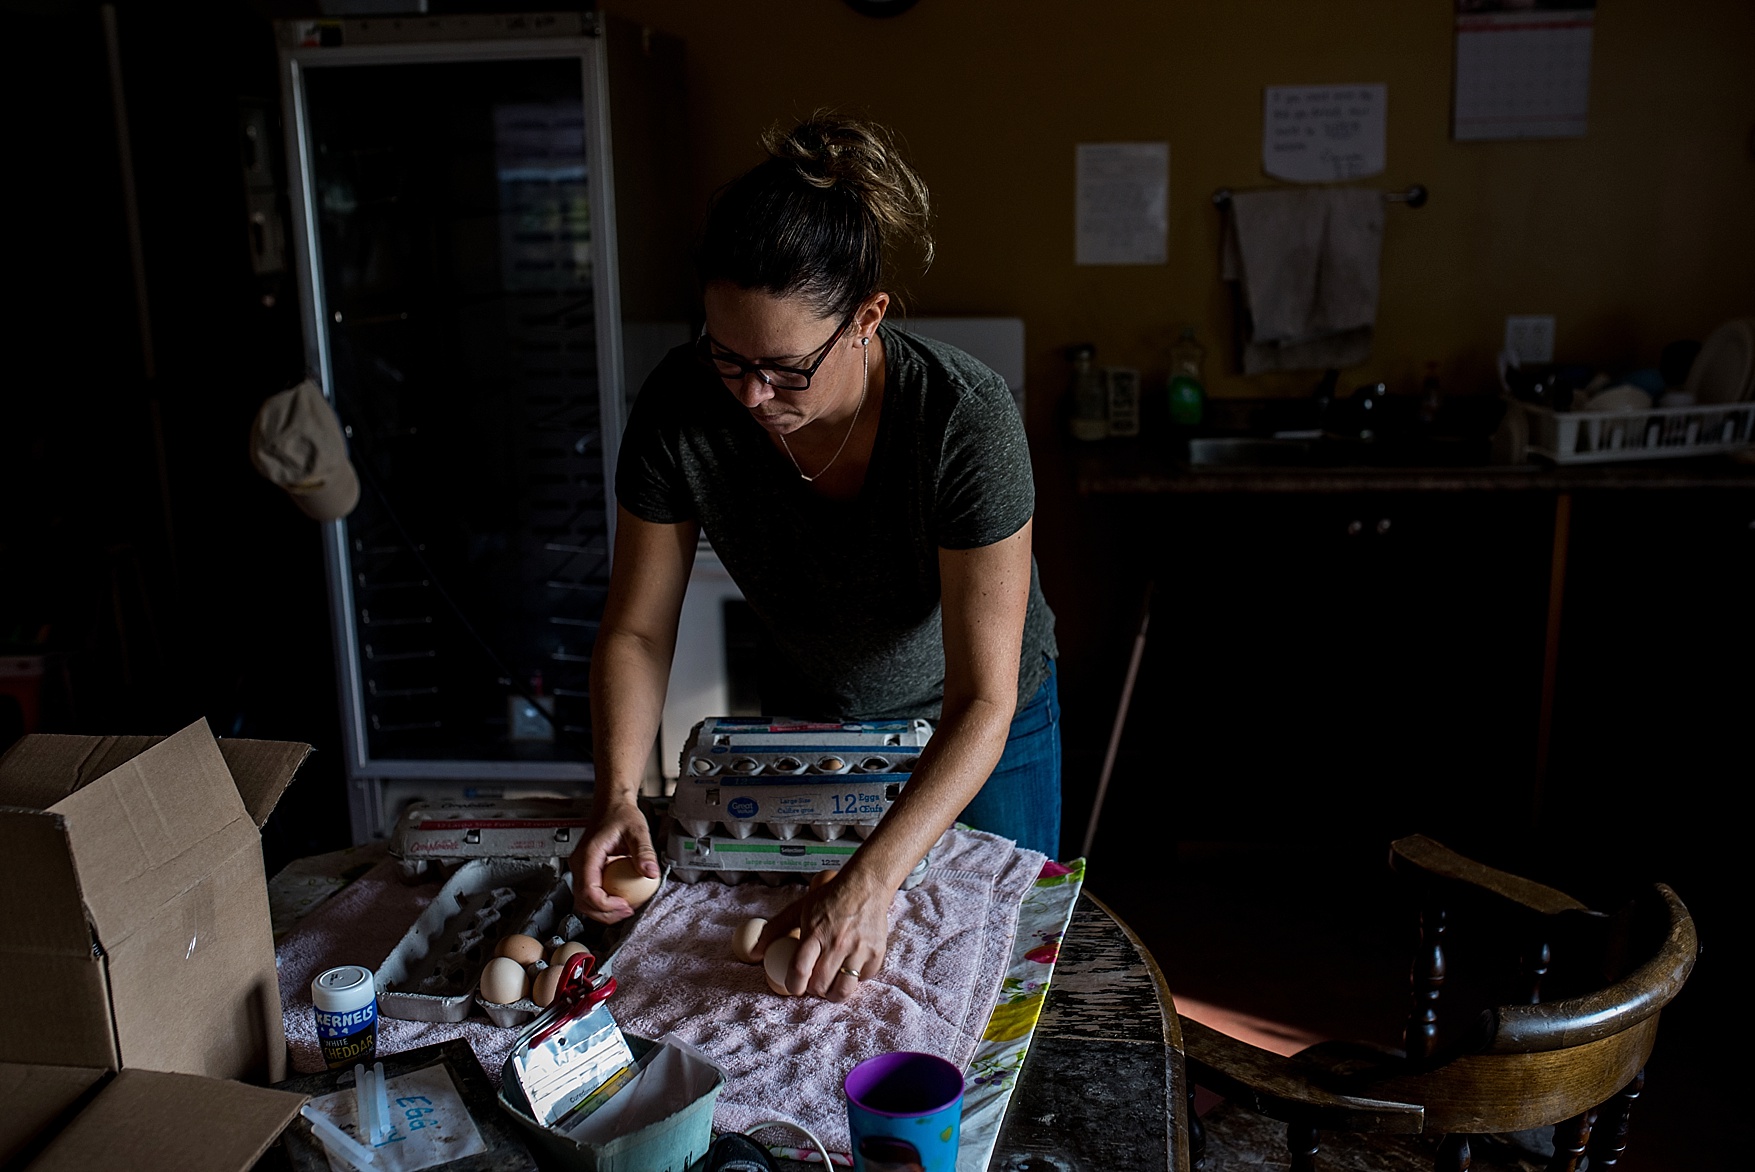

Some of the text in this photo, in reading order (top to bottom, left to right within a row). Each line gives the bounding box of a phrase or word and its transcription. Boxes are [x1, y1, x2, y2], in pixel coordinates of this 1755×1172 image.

[859, 793, 880, 802] Eggs
[732, 802, 753, 810] Great
[831, 794, 857, 814] 12
[859, 805, 883, 813] Œufs
[315, 1005, 373, 1028] KERNELS
[324, 1038, 349, 1047] WHITE
[324, 1035, 374, 1060] CHEDDAR
